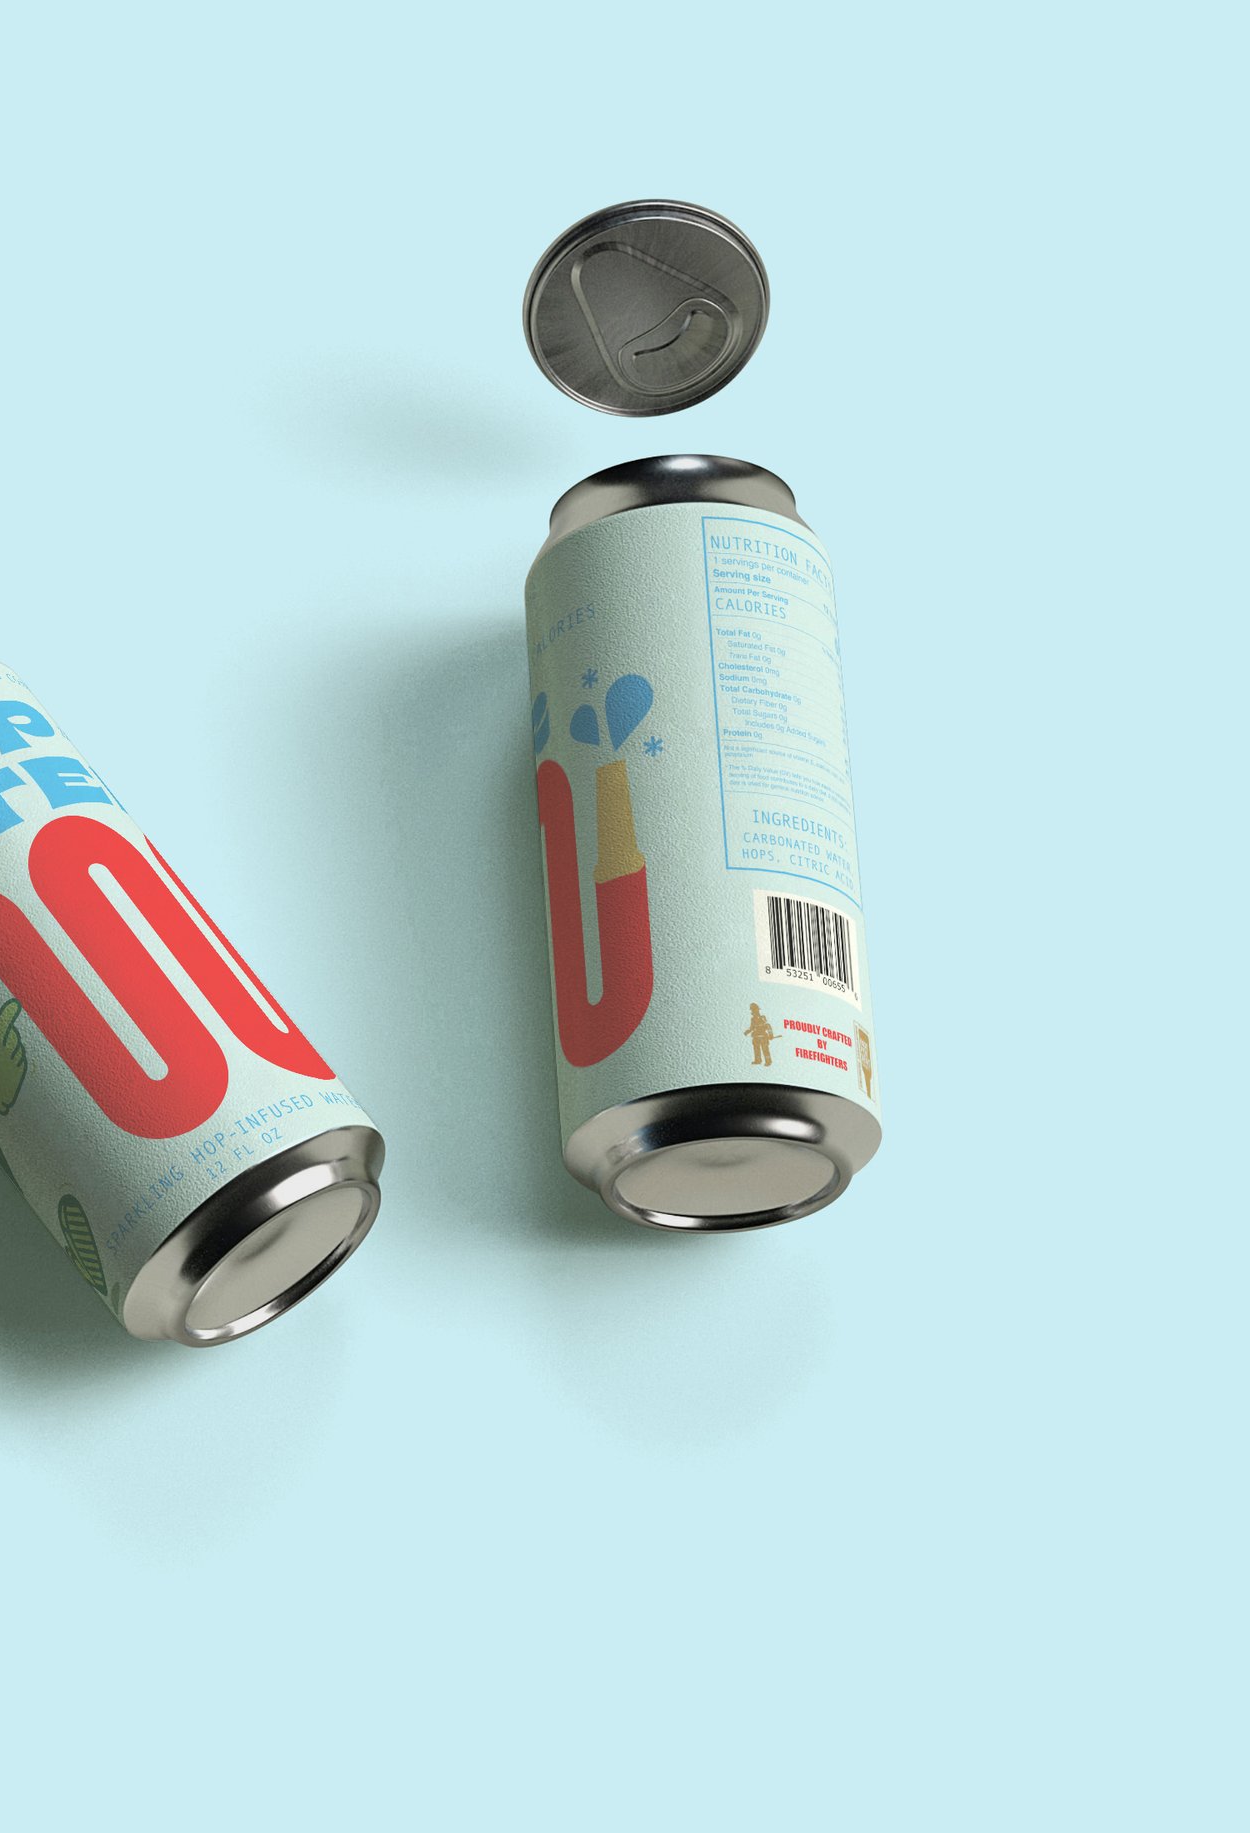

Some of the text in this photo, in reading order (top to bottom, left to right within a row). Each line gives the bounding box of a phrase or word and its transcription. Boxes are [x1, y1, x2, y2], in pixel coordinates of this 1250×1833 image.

[711, 535, 797, 566] NUTRITION
[714, 556, 718, 565] 1
[721, 557, 759, 570] servings
[762, 560, 775, 573] per
[713, 569, 771, 584] Serving size
[714, 586, 789, 605] Amount Per Serving
[715, 597, 787, 619] CALORIES
[535, 603, 596, 657] ALORIES
[716, 628, 762, 640] Total Fat 0g
[718, 662, 763, 672] Cholesterol
[719, 674, 749, 682] Sodium
[719, 685, 740, 693] Total
[742, 686, 792, 701] Carbohydrate
[723, 728, 752, 738] Protein
[743, 832, 820, 856] CARBONATED
[789, 854, 830, 876] CITRIC
[765, 965, 772, 975] 8
[786, 968, 814, 981] 53251
[822, 976, 846, 993] 00655
[783, 1019, 853, 1048] PROUDLY CRAFTED
[817, 1038, 827, 1050] BY
[795, 1047, 848, 1071] FIREFIGHTERS
[206, 1127, 284, 1180] 12 FL OZ
[106, 1163, 185, 1253] SPARKLING
[190, 1094, 314, 1165] HOP-INFUSED
